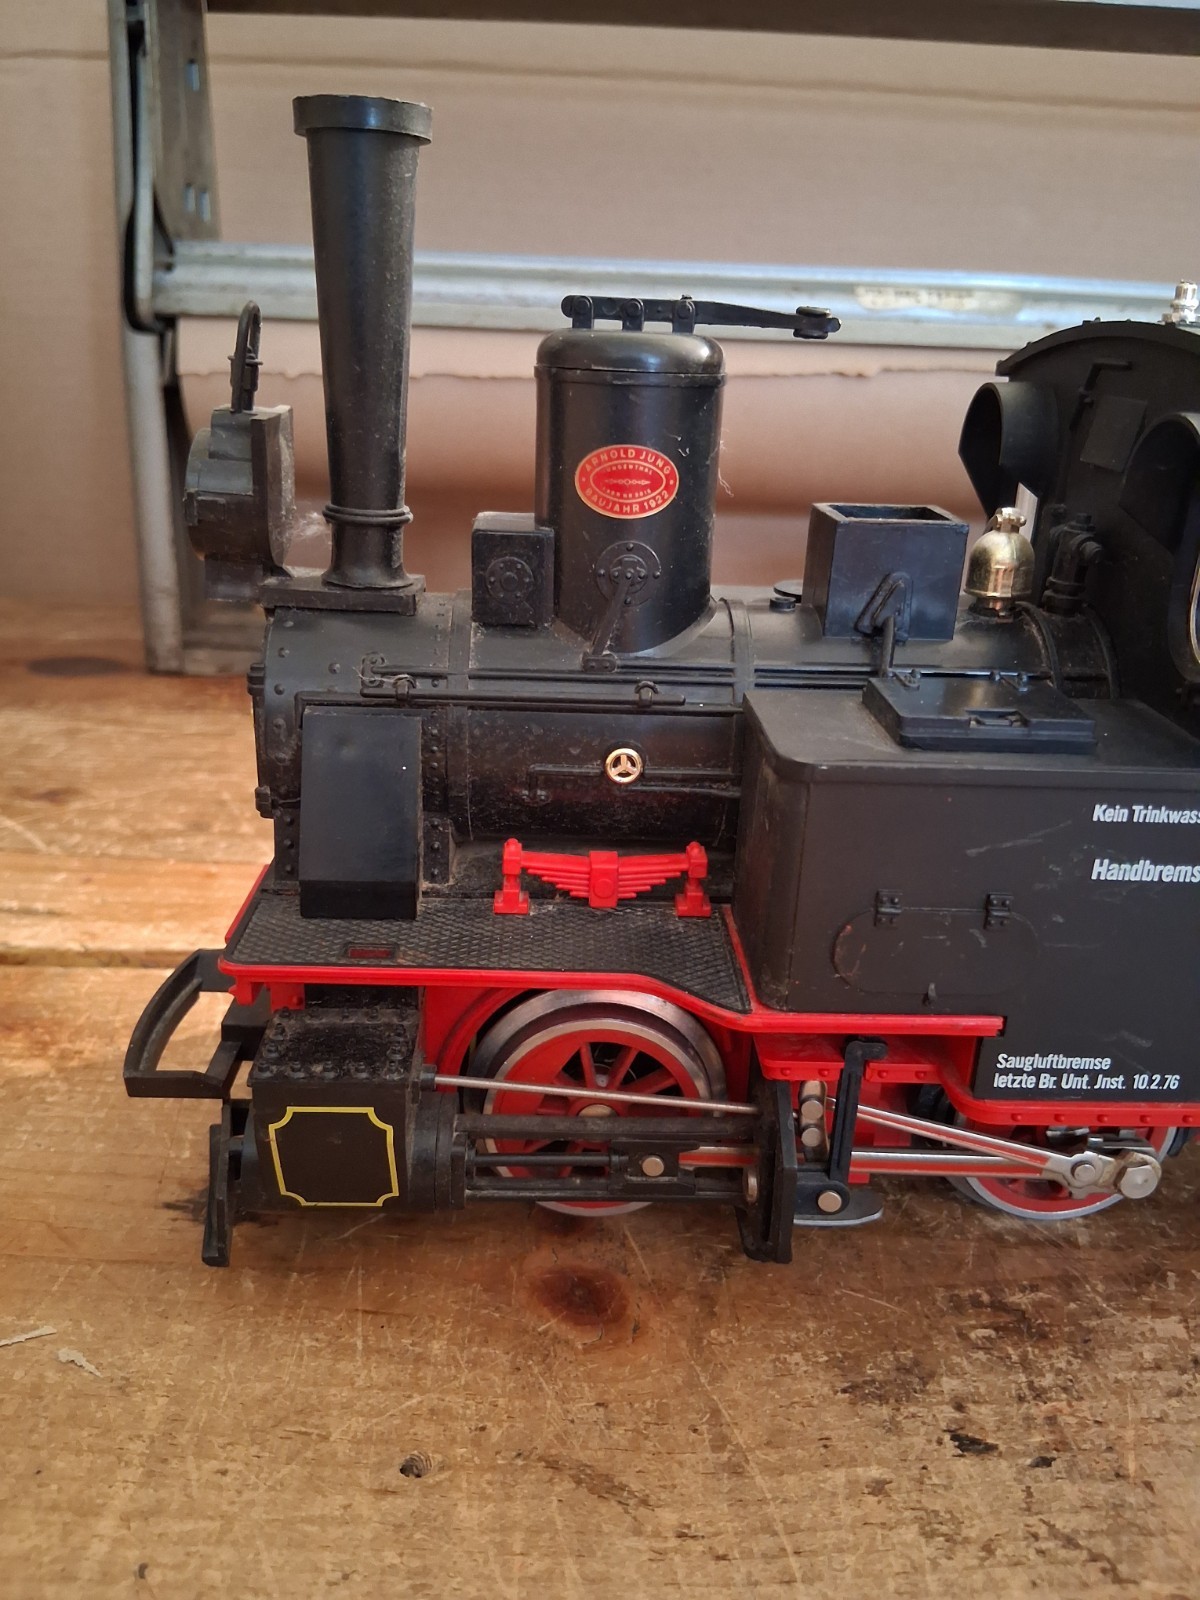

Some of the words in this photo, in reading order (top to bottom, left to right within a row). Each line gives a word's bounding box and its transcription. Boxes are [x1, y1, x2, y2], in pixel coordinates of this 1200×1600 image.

[585, 449, 636, 472] ARNOLD
[640, 451, 671, 474] JUNG
[586, 487, 640, 514] BAUJAHR
[643, 490, 669, 510] 1922
[1092, 804, 1129, 822] Kein
[1091, 858, 1200, 883] Handbrems
[996, 1053, 1111, 1072] Saugluftbremse
[993, 1072, 1036, 1089] letzte
[1038, 1073, 1058, 1090] Br.
[1060, 1074, 1091, 1090] Unt.
[1132, 1074, 1181, 1091] 10.2.76
